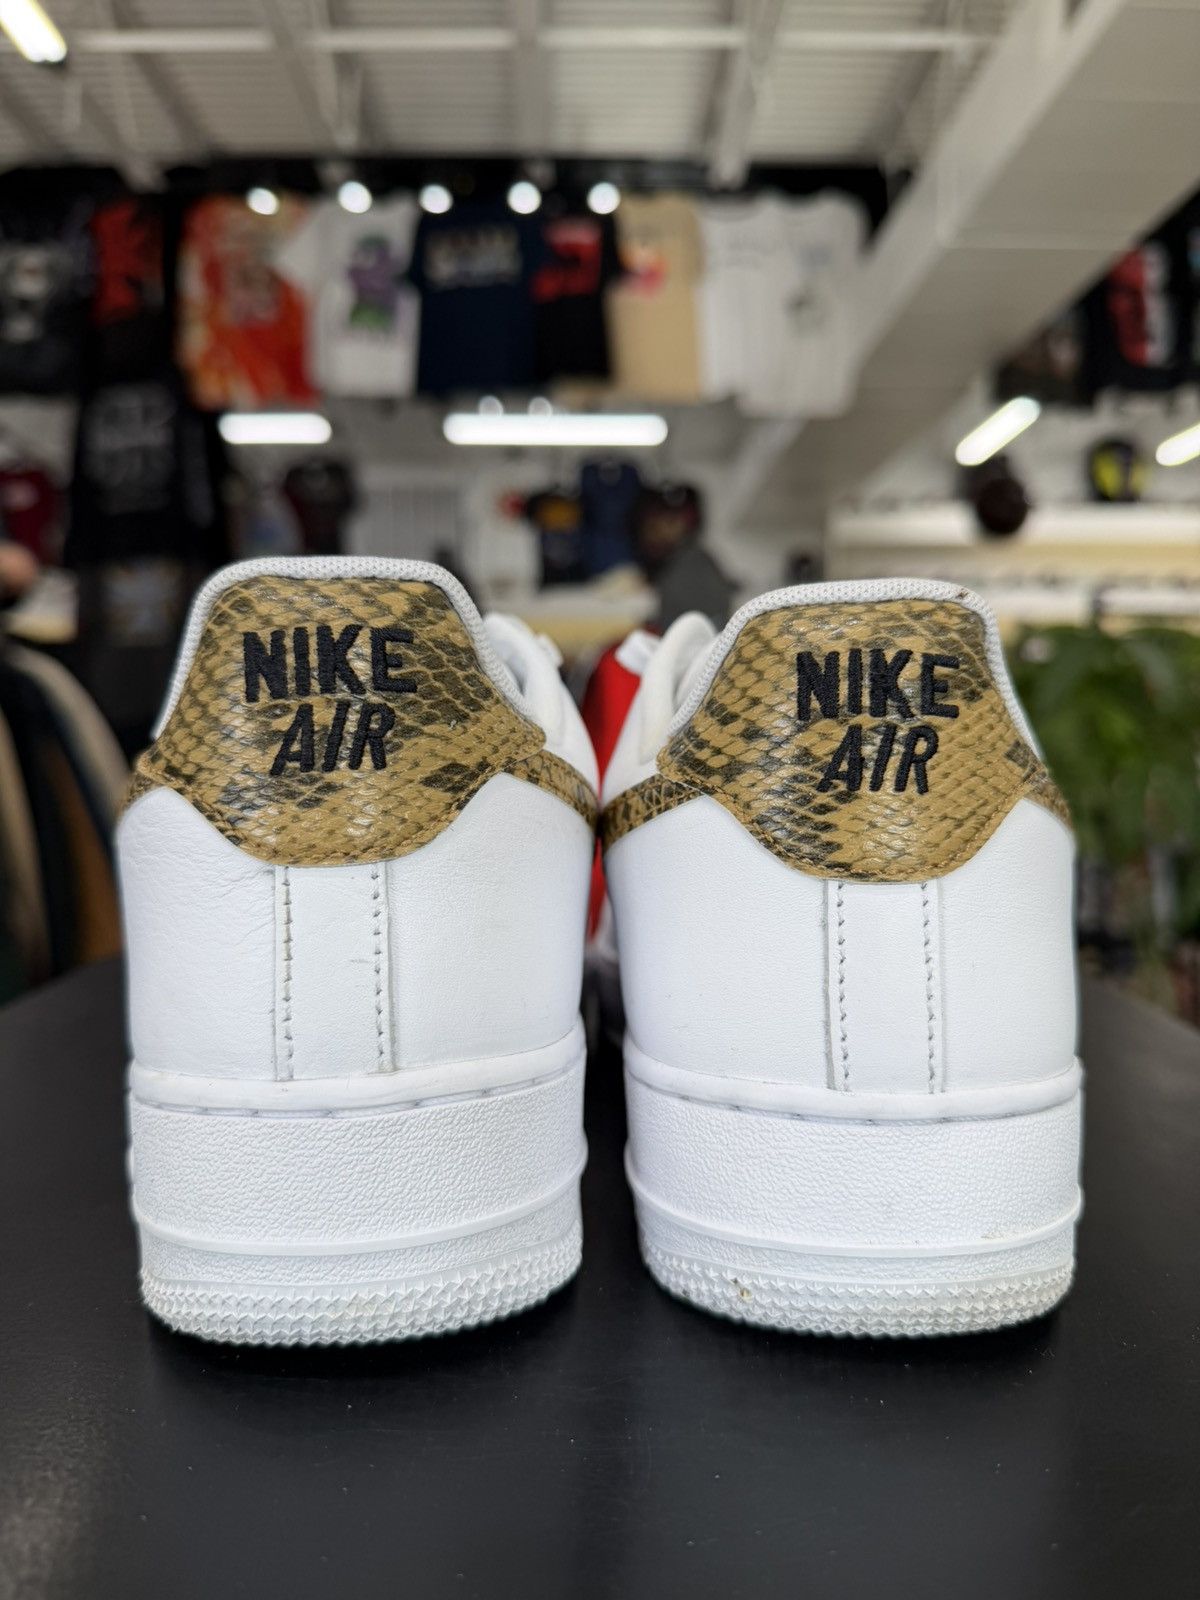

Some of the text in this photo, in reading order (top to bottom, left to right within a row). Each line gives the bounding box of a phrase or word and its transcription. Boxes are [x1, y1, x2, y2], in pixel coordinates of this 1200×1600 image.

[243, 624, 418, 703] NIKE
[796, 648, 960, 721] NIKE
[269, 701, 396, 777] AIR
[815, 723, 939, 795] AIR
